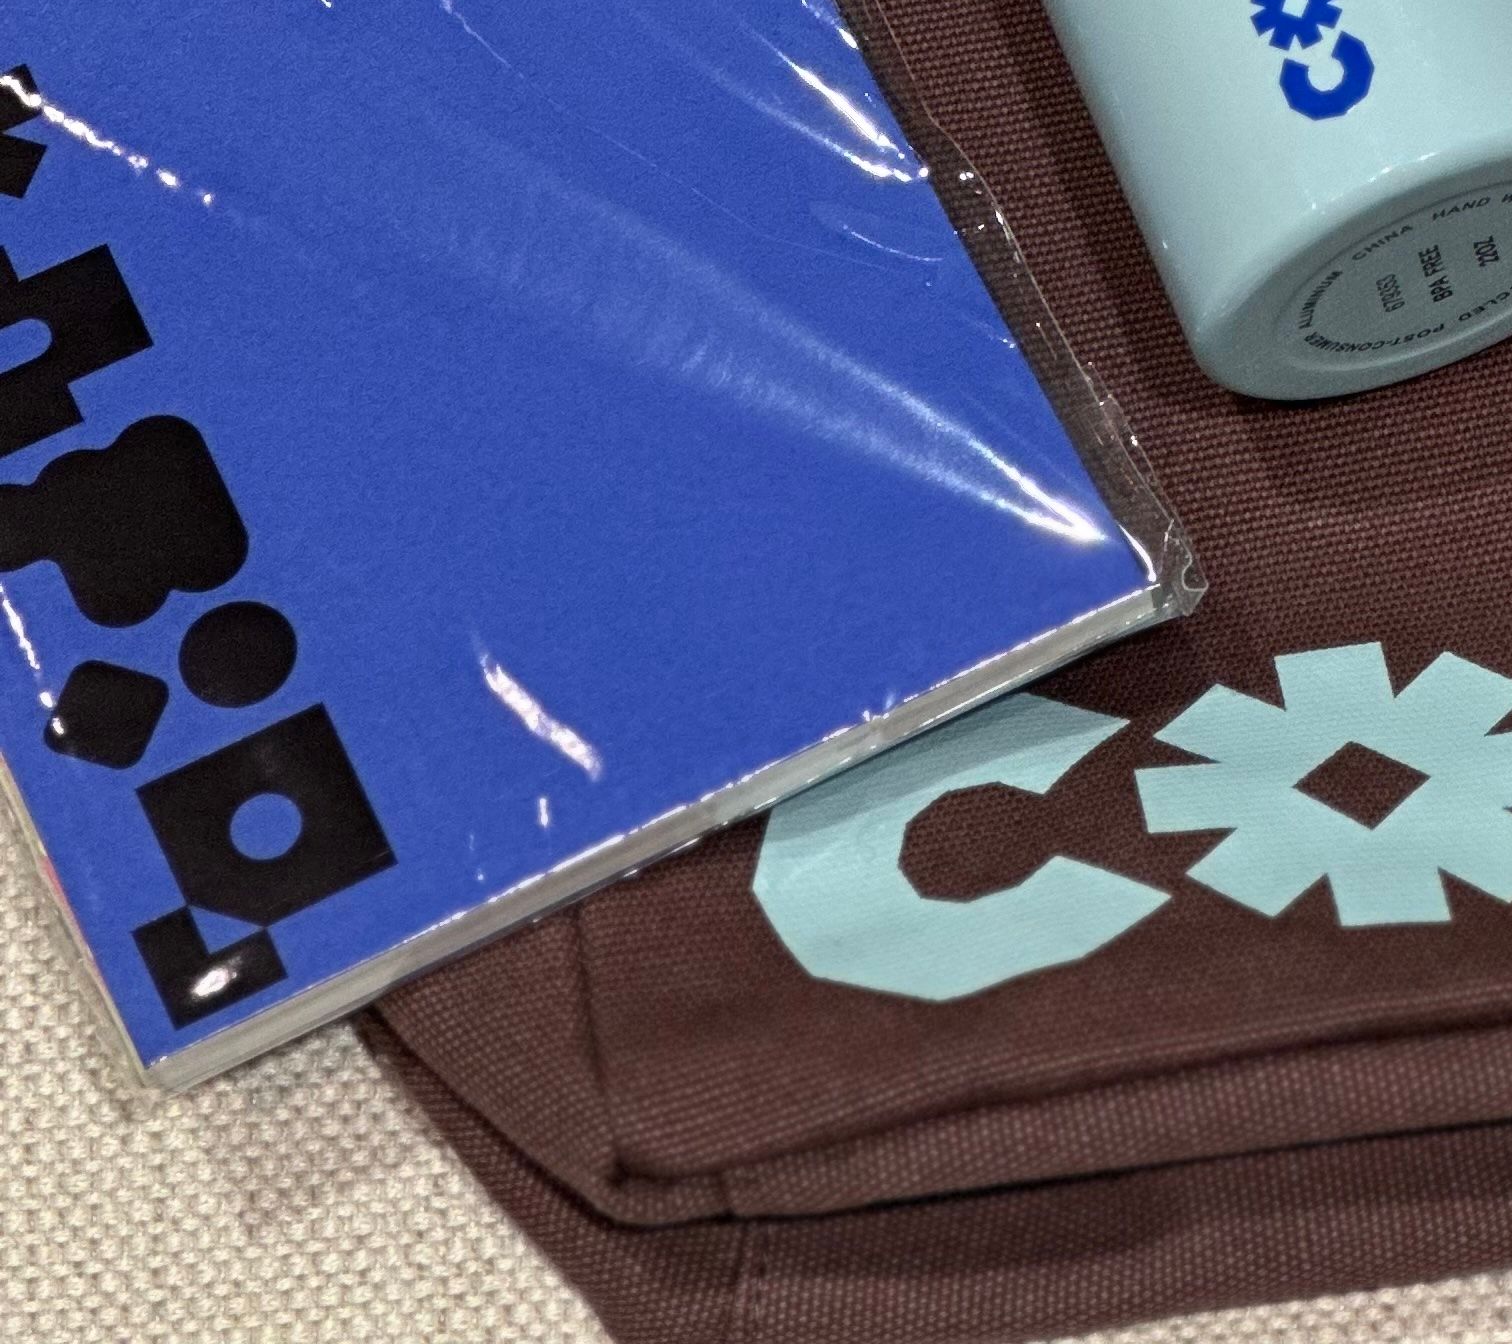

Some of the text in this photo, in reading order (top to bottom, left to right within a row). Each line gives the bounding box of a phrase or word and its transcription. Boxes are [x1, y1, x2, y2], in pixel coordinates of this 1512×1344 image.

[1432, 197, 1490, 221] HAND
[1352, 224, 1413, 261] CHINA
[1418, 244, 1453, 302] BPA FREE
